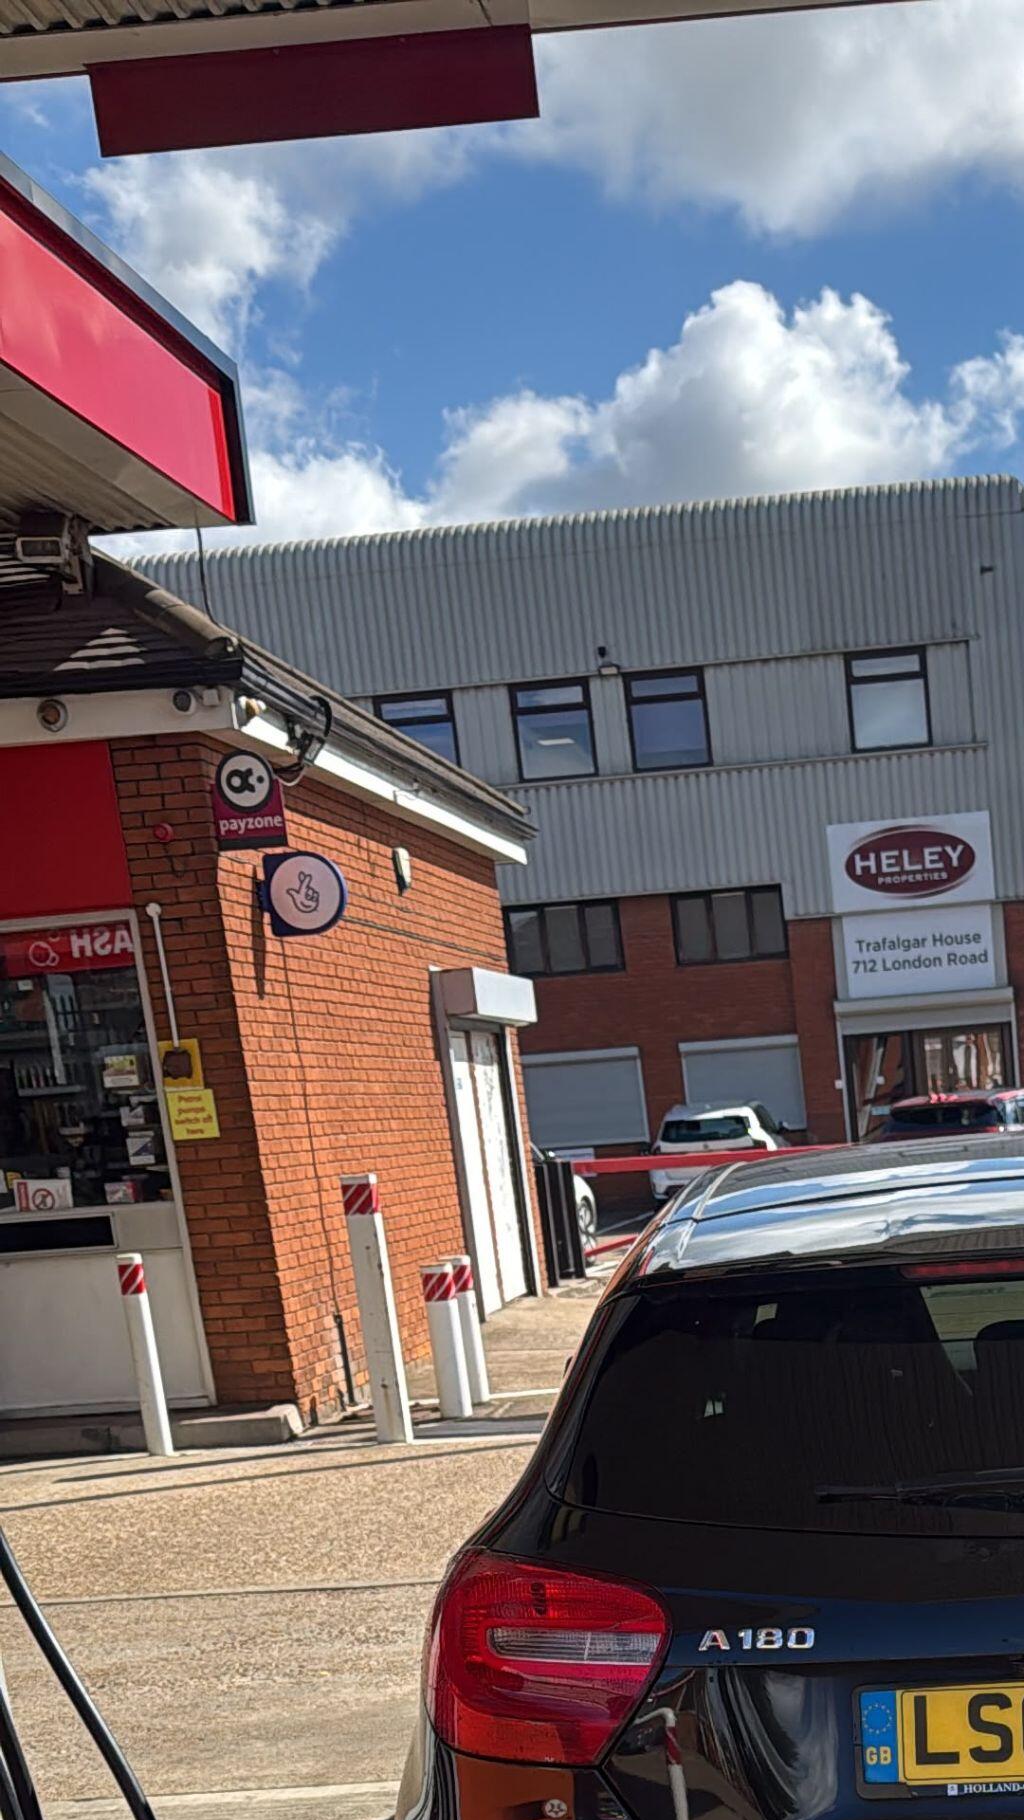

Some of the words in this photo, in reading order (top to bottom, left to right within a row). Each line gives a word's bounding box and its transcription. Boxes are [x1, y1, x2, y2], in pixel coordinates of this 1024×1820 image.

[218, 814, 284, 836] payzone
[853, 844, 965, 876] HELEY
[877, 871, 949, 886] PROPERTIES
[855, 934, 928, 953] Trafalgar
[932, 932, 982, 947] House
[852, 959, 878, 974] 712
[882, 952, 943, 972] London
[946, 950, 989, 966] Road
[698, 1629, 731, 1651] A
[738, 1627, 815, 1650] 180
[865, 1745, 892, 1766] GB
